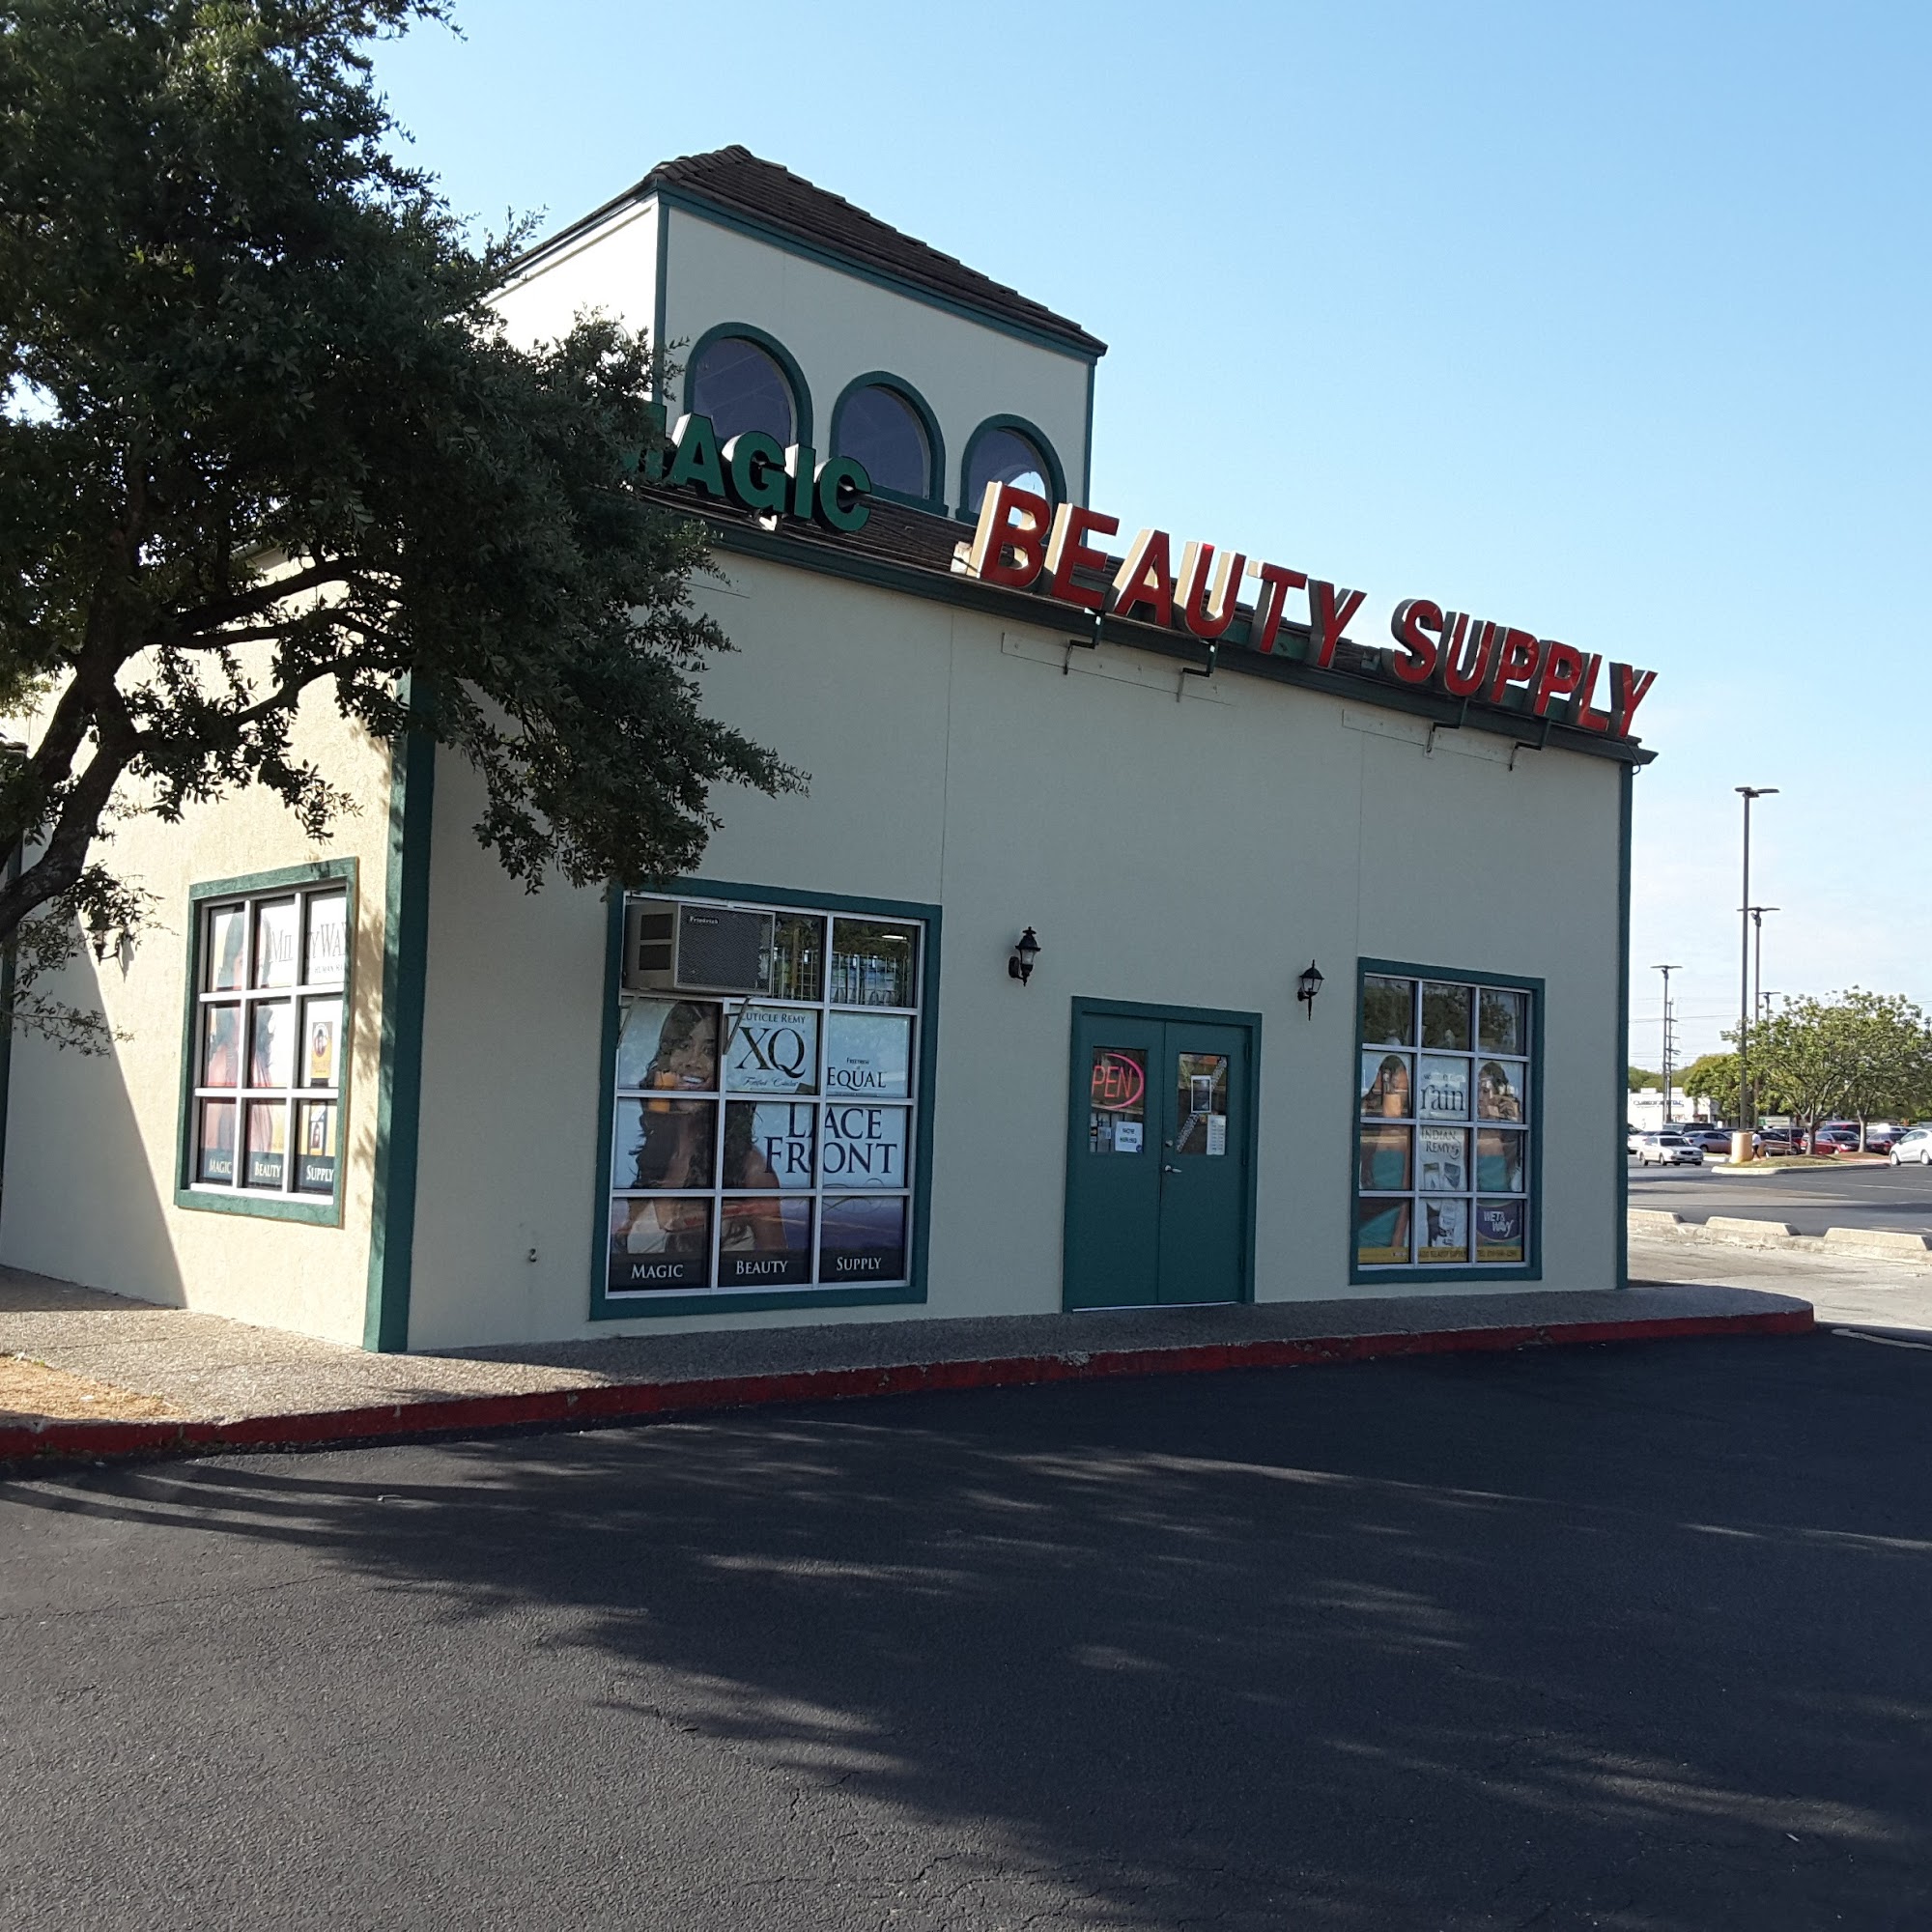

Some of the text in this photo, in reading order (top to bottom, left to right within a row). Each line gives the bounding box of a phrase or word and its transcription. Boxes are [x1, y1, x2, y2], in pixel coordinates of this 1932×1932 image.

[972, 481, 1367, 668] BEAUTY
[1391, 598, 1659, 739] SUPPLY
[781, 1011, 806, 1024] REMY
[734, 1026, 806, 1078] XQ
[827, 1066, 888, 1092] EQUAL
[1420, 1084, 1465, 1111] rain
[787, 1101, 883, 1140] LACE
[763, 1136, 898, 1175] FRONT
[208, 1158, 334, 1182] MAGIC BEAUTY SUPPLY
[631, 1256, 883, 1280] MAGIC BEAUTY SUPPLY
